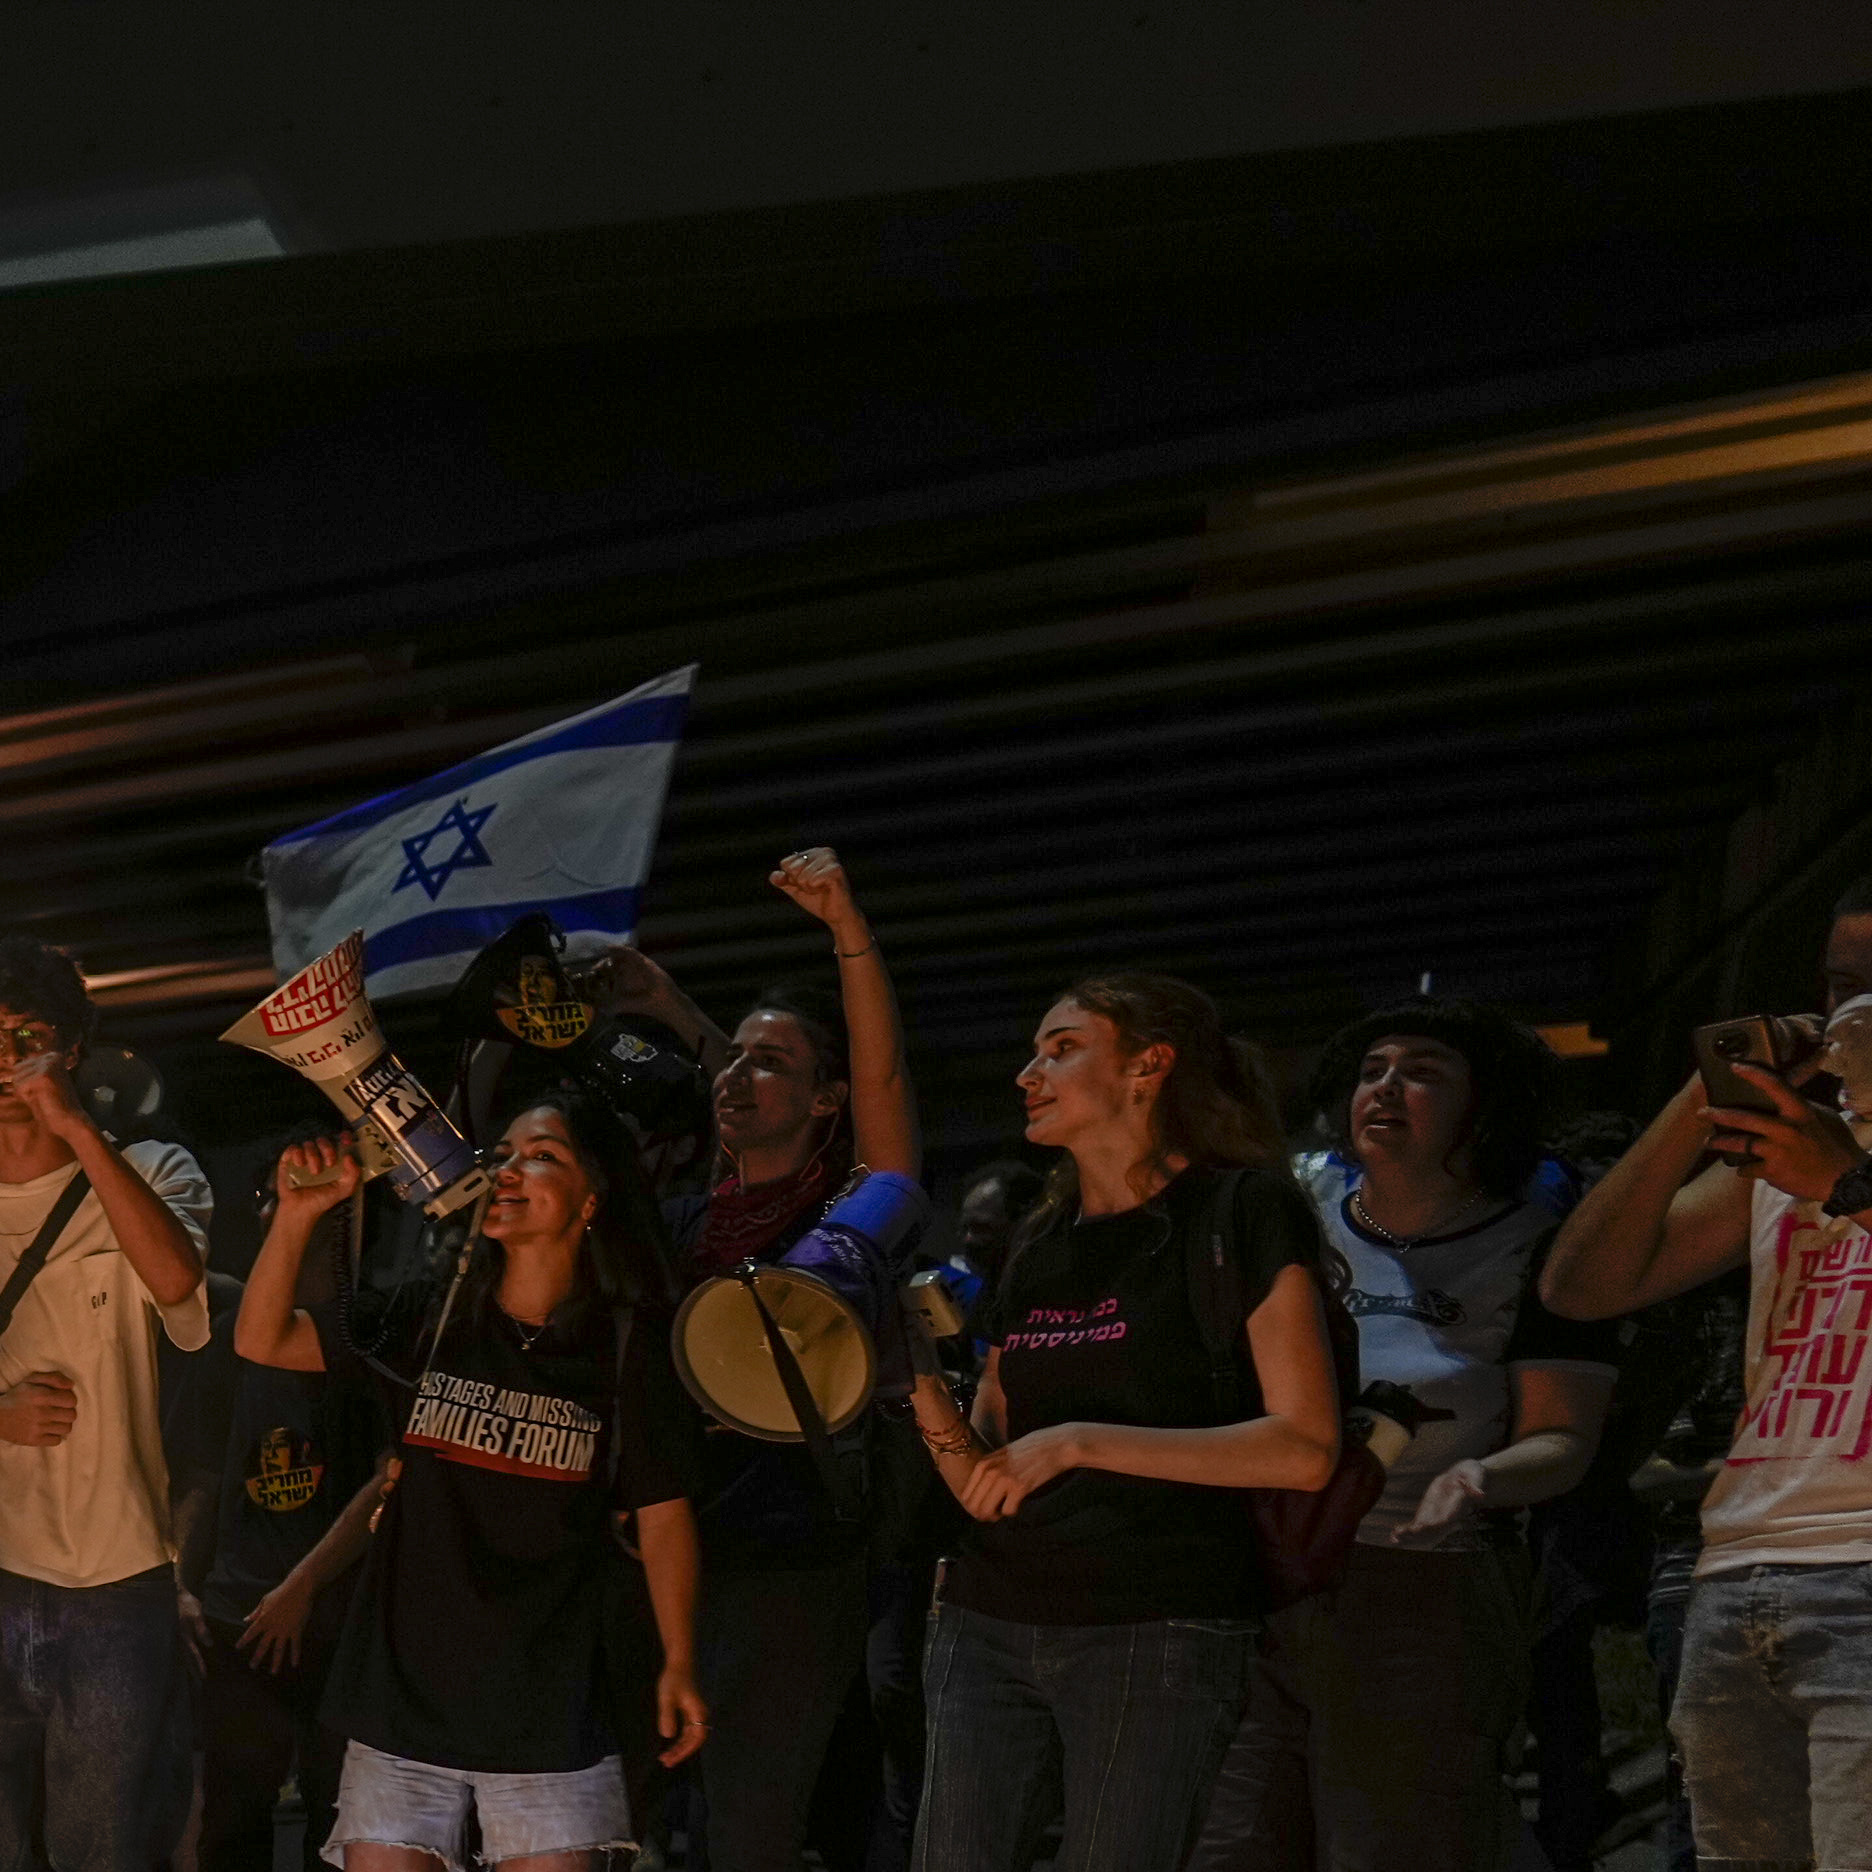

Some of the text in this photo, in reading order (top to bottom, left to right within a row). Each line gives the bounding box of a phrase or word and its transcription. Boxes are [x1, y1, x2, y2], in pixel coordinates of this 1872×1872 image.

[1003, 1320, 1127, 1353] פמיניסטית
[491, 1388, 530, 1419] AND
[407, 1398, 596, 1472] FAMILIES FORUM
